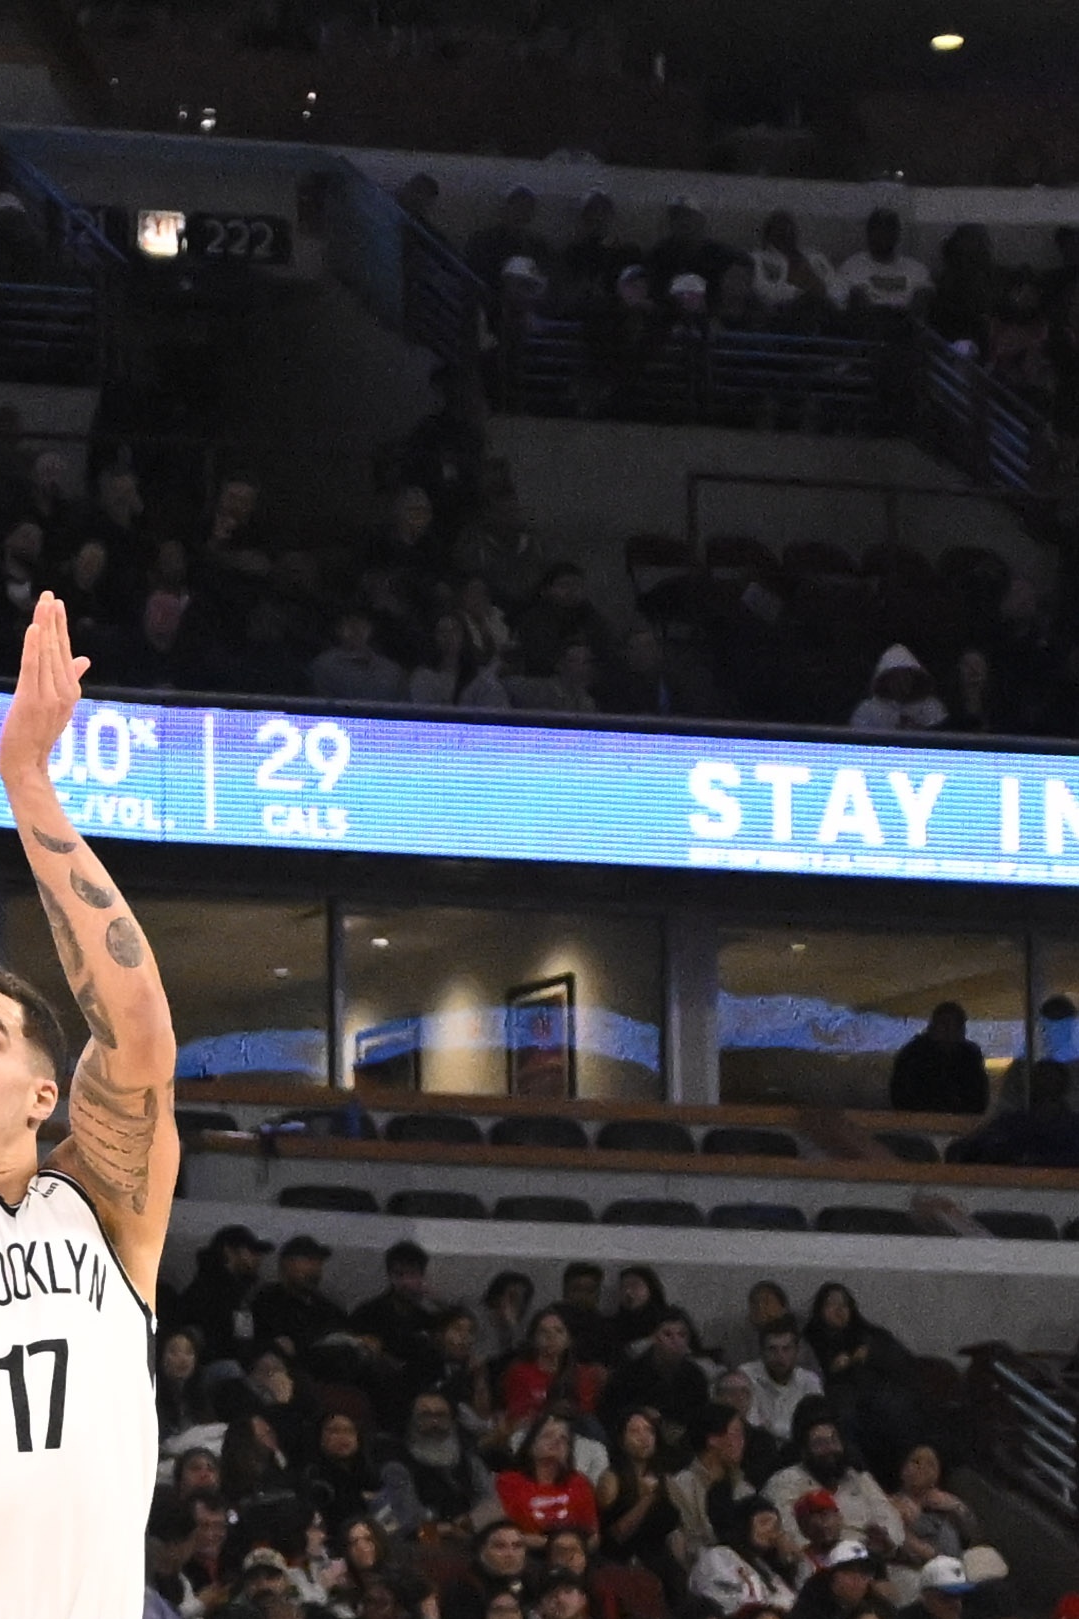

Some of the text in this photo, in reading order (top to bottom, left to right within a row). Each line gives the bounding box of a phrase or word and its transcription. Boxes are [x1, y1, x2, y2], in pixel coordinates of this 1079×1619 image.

[255, 719, 351, 792] 29
[263, 804, 349, 839] CALS
[688, 760, 946, 849] STAY
